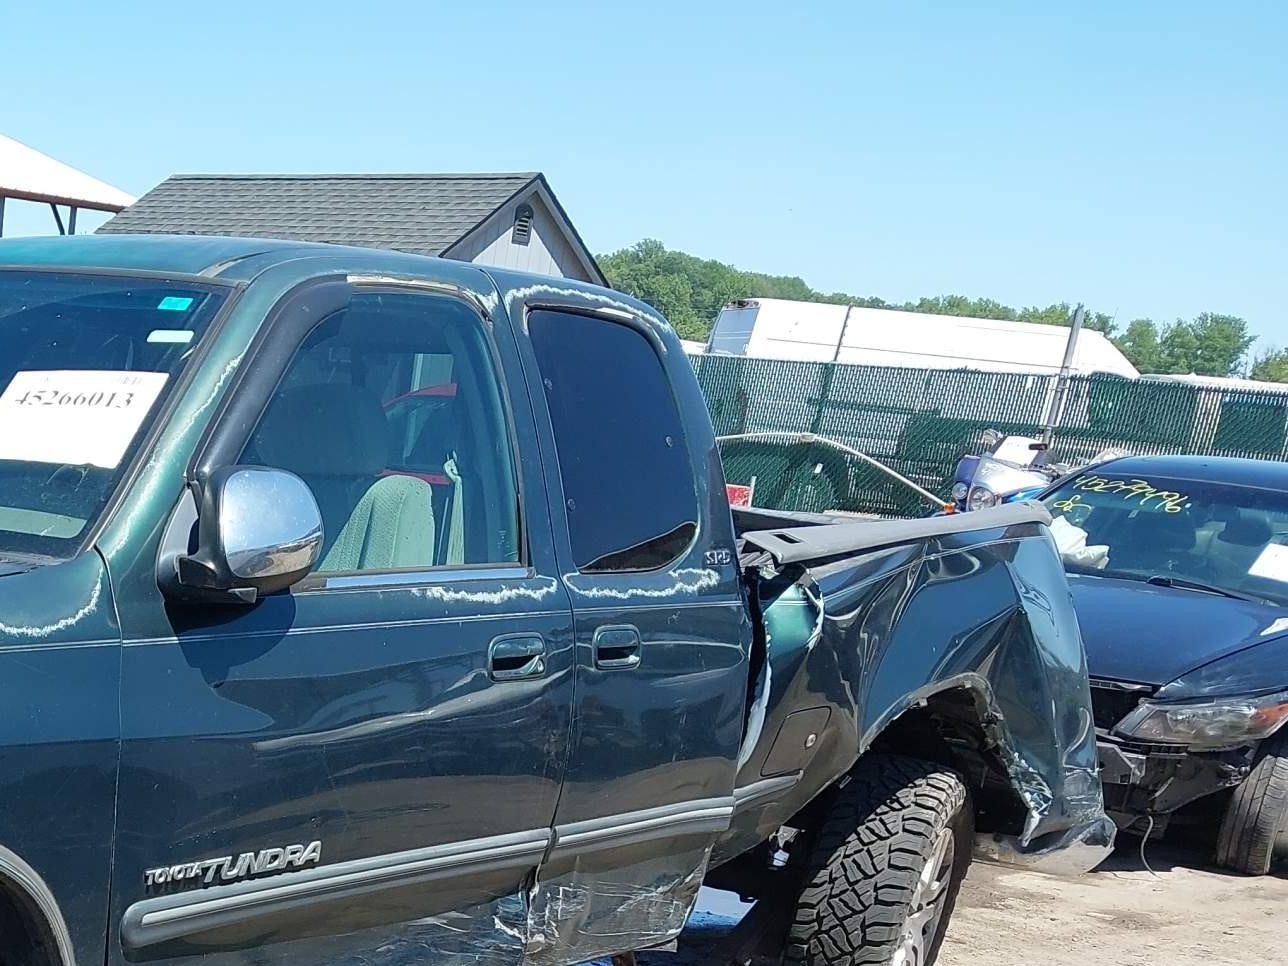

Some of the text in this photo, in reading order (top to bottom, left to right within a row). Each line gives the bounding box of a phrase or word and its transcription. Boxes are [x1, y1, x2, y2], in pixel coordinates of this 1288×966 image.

[14, 389, 135, 409] 45266013
[145, 840, 323, 886] TOYOTA TUNDRA
